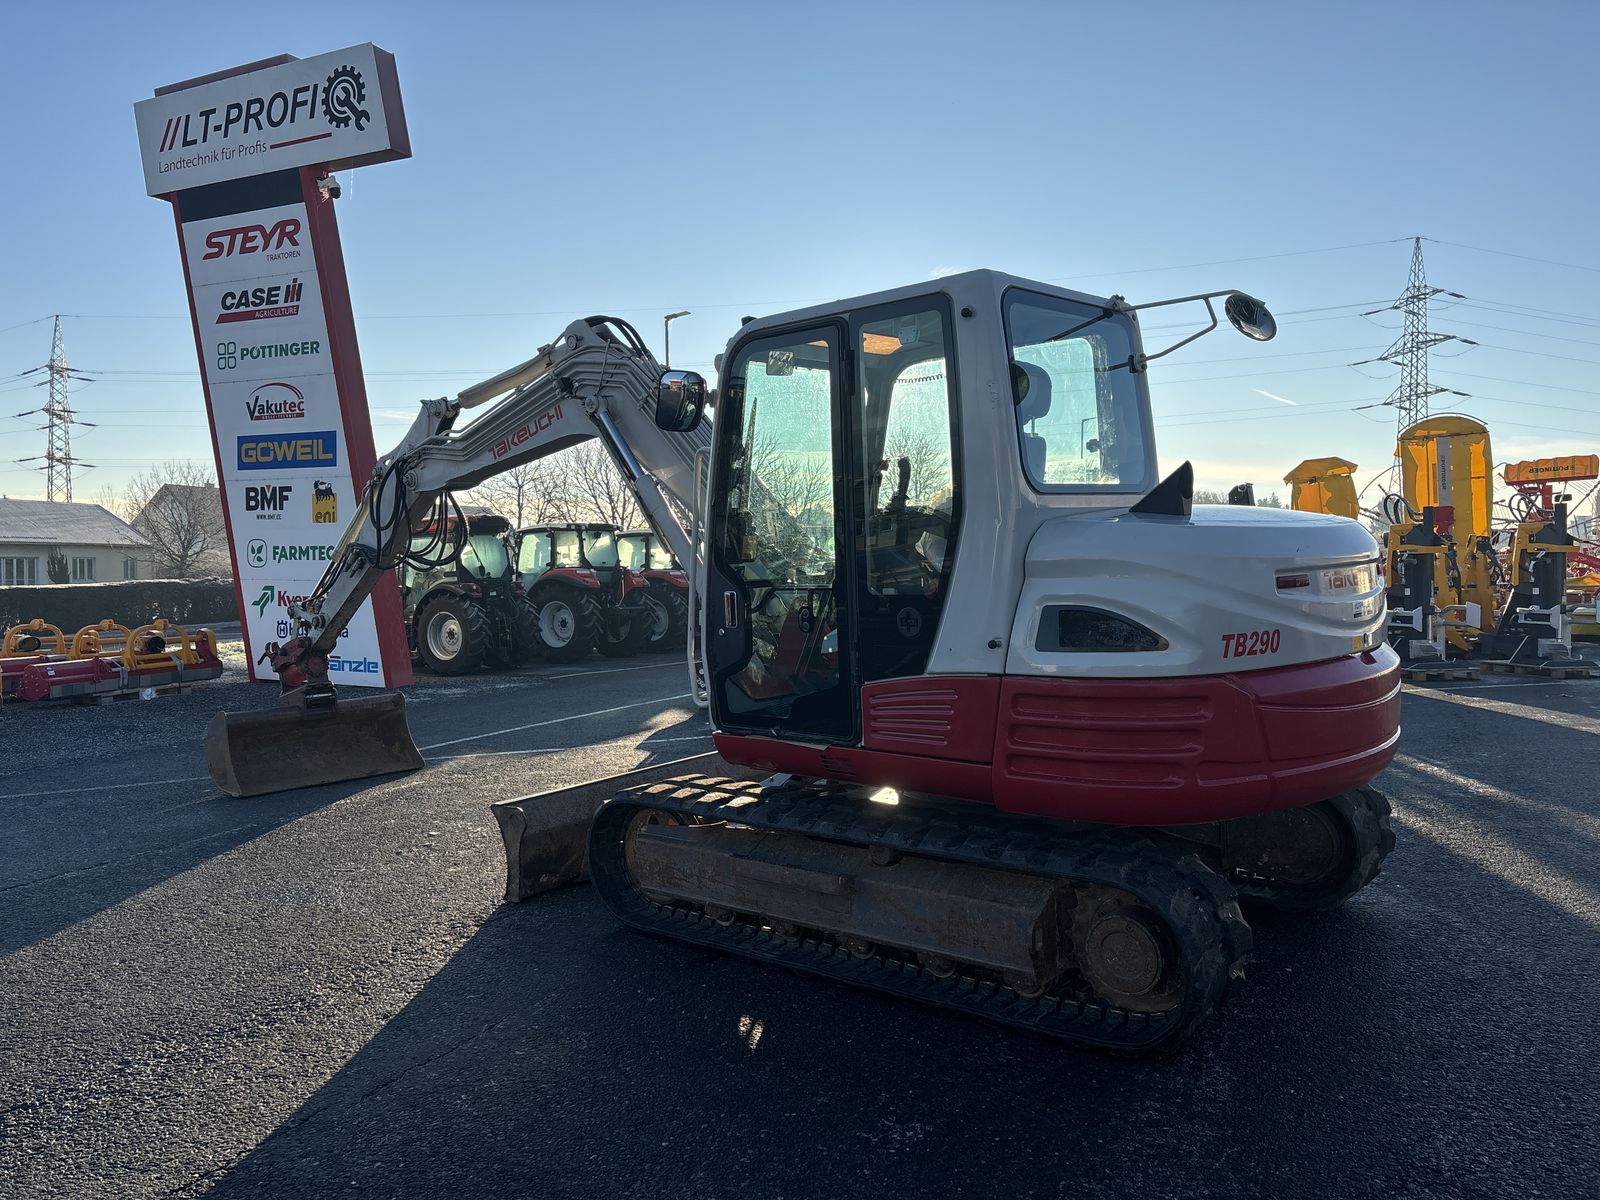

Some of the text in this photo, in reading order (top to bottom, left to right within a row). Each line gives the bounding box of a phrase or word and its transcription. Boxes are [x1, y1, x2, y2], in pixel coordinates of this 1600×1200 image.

[158, 140, 267, 174] Landtechnik für Profis
[202, 218, 301, 261] STEYR
[266, 251, 301, 262] TRAKTOREN
[220, 285, 281, 310] CASE
[255, 307, 297, 318] AGRICULTURE
[240, 340, 320, 361] PÖTTINGER
[245, 395, 305, 421] Vakutec
[245, 485, 292, 511] BMF
[314, 506, 336, 523] eni
[272, 545, 335, 563] FARMTEC
[1221, 629, 1281, 659] TB290
[329, 655, 379, 673] änzle
